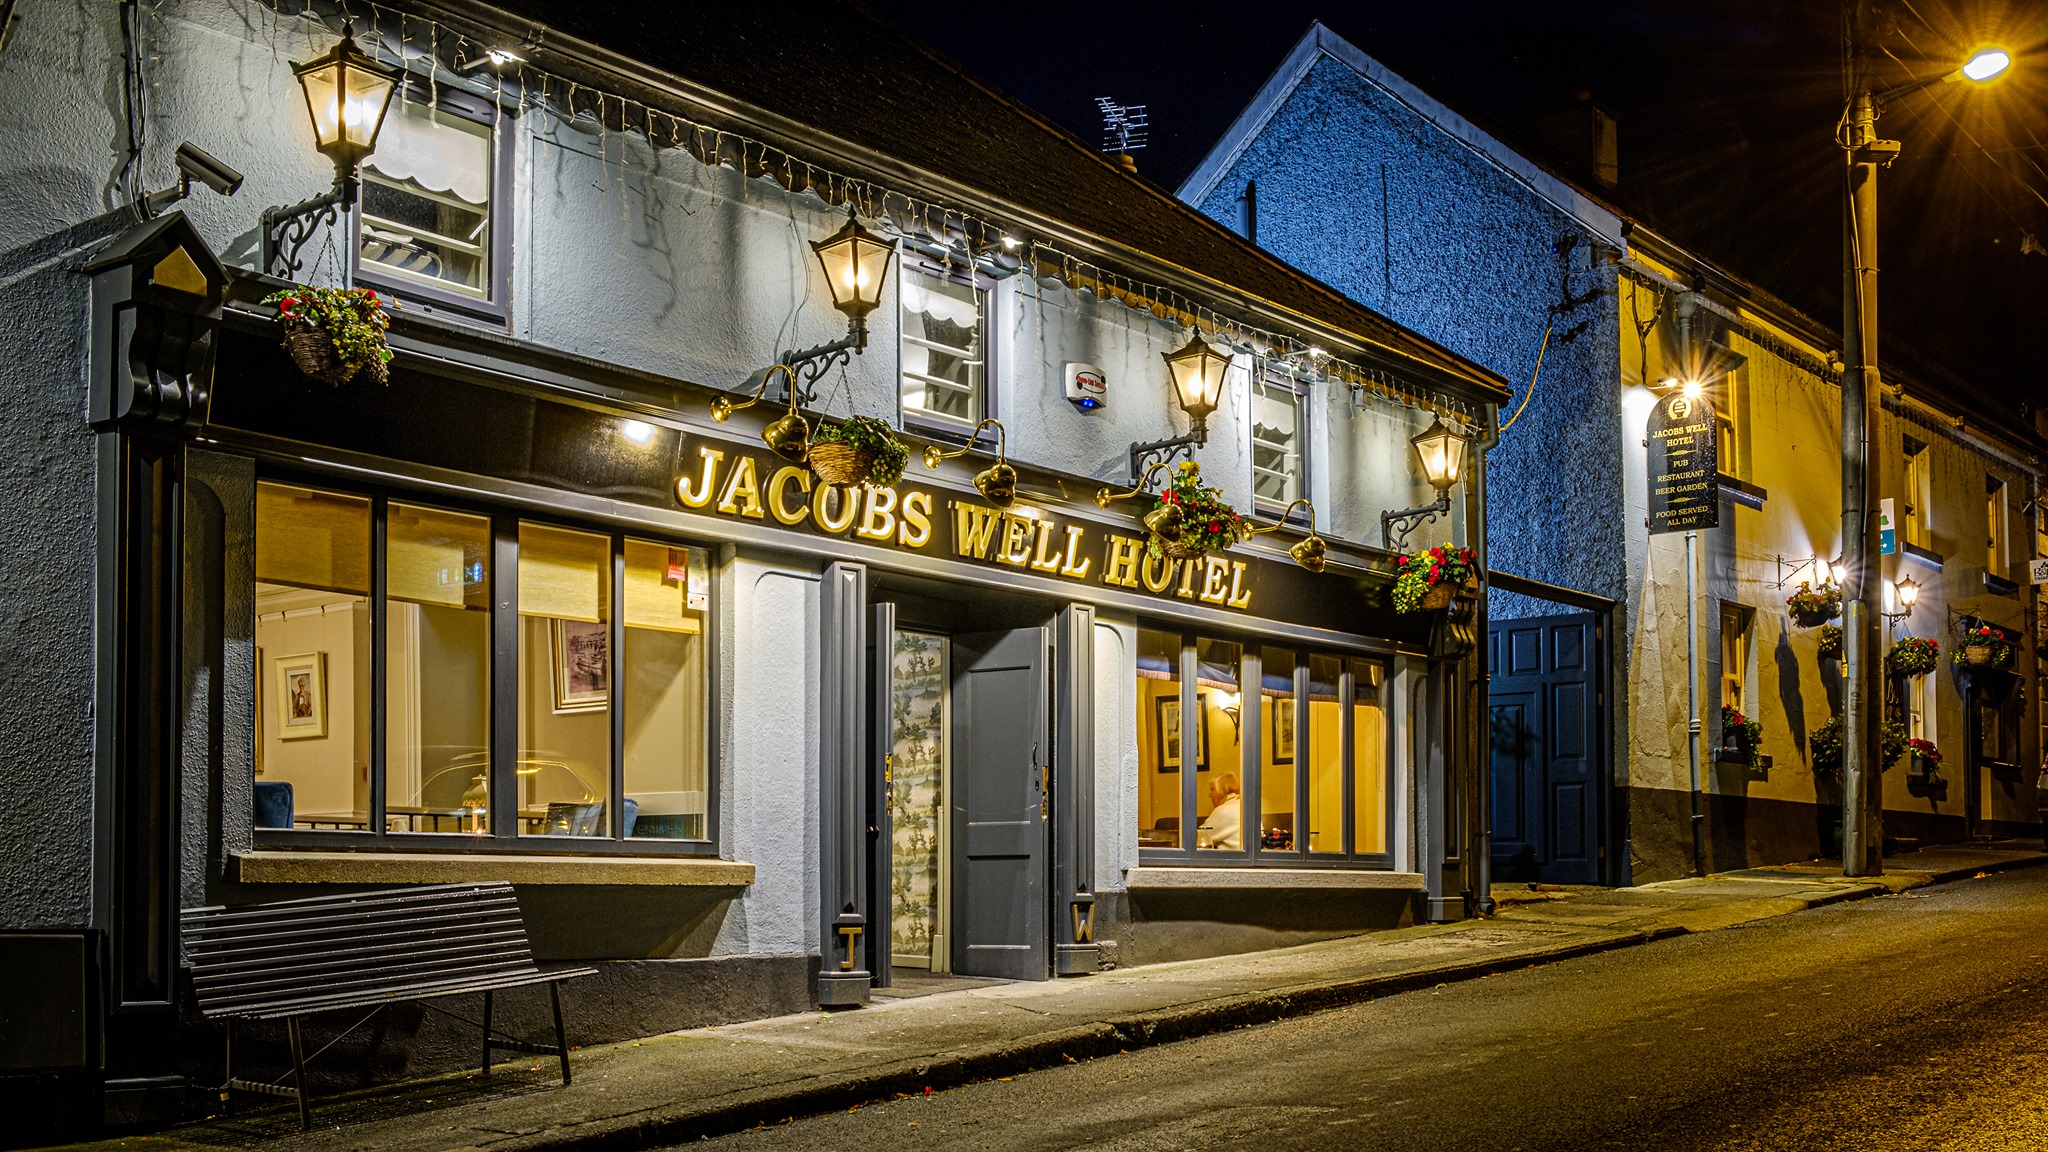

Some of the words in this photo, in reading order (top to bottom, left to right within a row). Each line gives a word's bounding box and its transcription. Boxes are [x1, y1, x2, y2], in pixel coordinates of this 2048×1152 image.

[1652, 426, 1684, 439] JACOBS
[1685, 423, 1708, 432] WELL
[1666, 436, 1694, 447] HOTEL
[1673, 460, 1688, 468] PUB
[1657, 470, 1706, 483] RESTAURANT
[1655, 486, 1676, 496] BEER
[1676, 482, 1708, 492] GARDEN
[1656, 509, 1677, 519] FOOD
[1678, 505, 1708, 516] SERVED
[677, 447, 933, 549] JACOBS
[953, 501, 1091, 579] WELL
[1104, 534, 1252, 610] HOTEL
[1667, 518, 1680, 527] ALL
[1682, 516, 1697, 524] DAY
[1073, 904, 1095, 941] W
